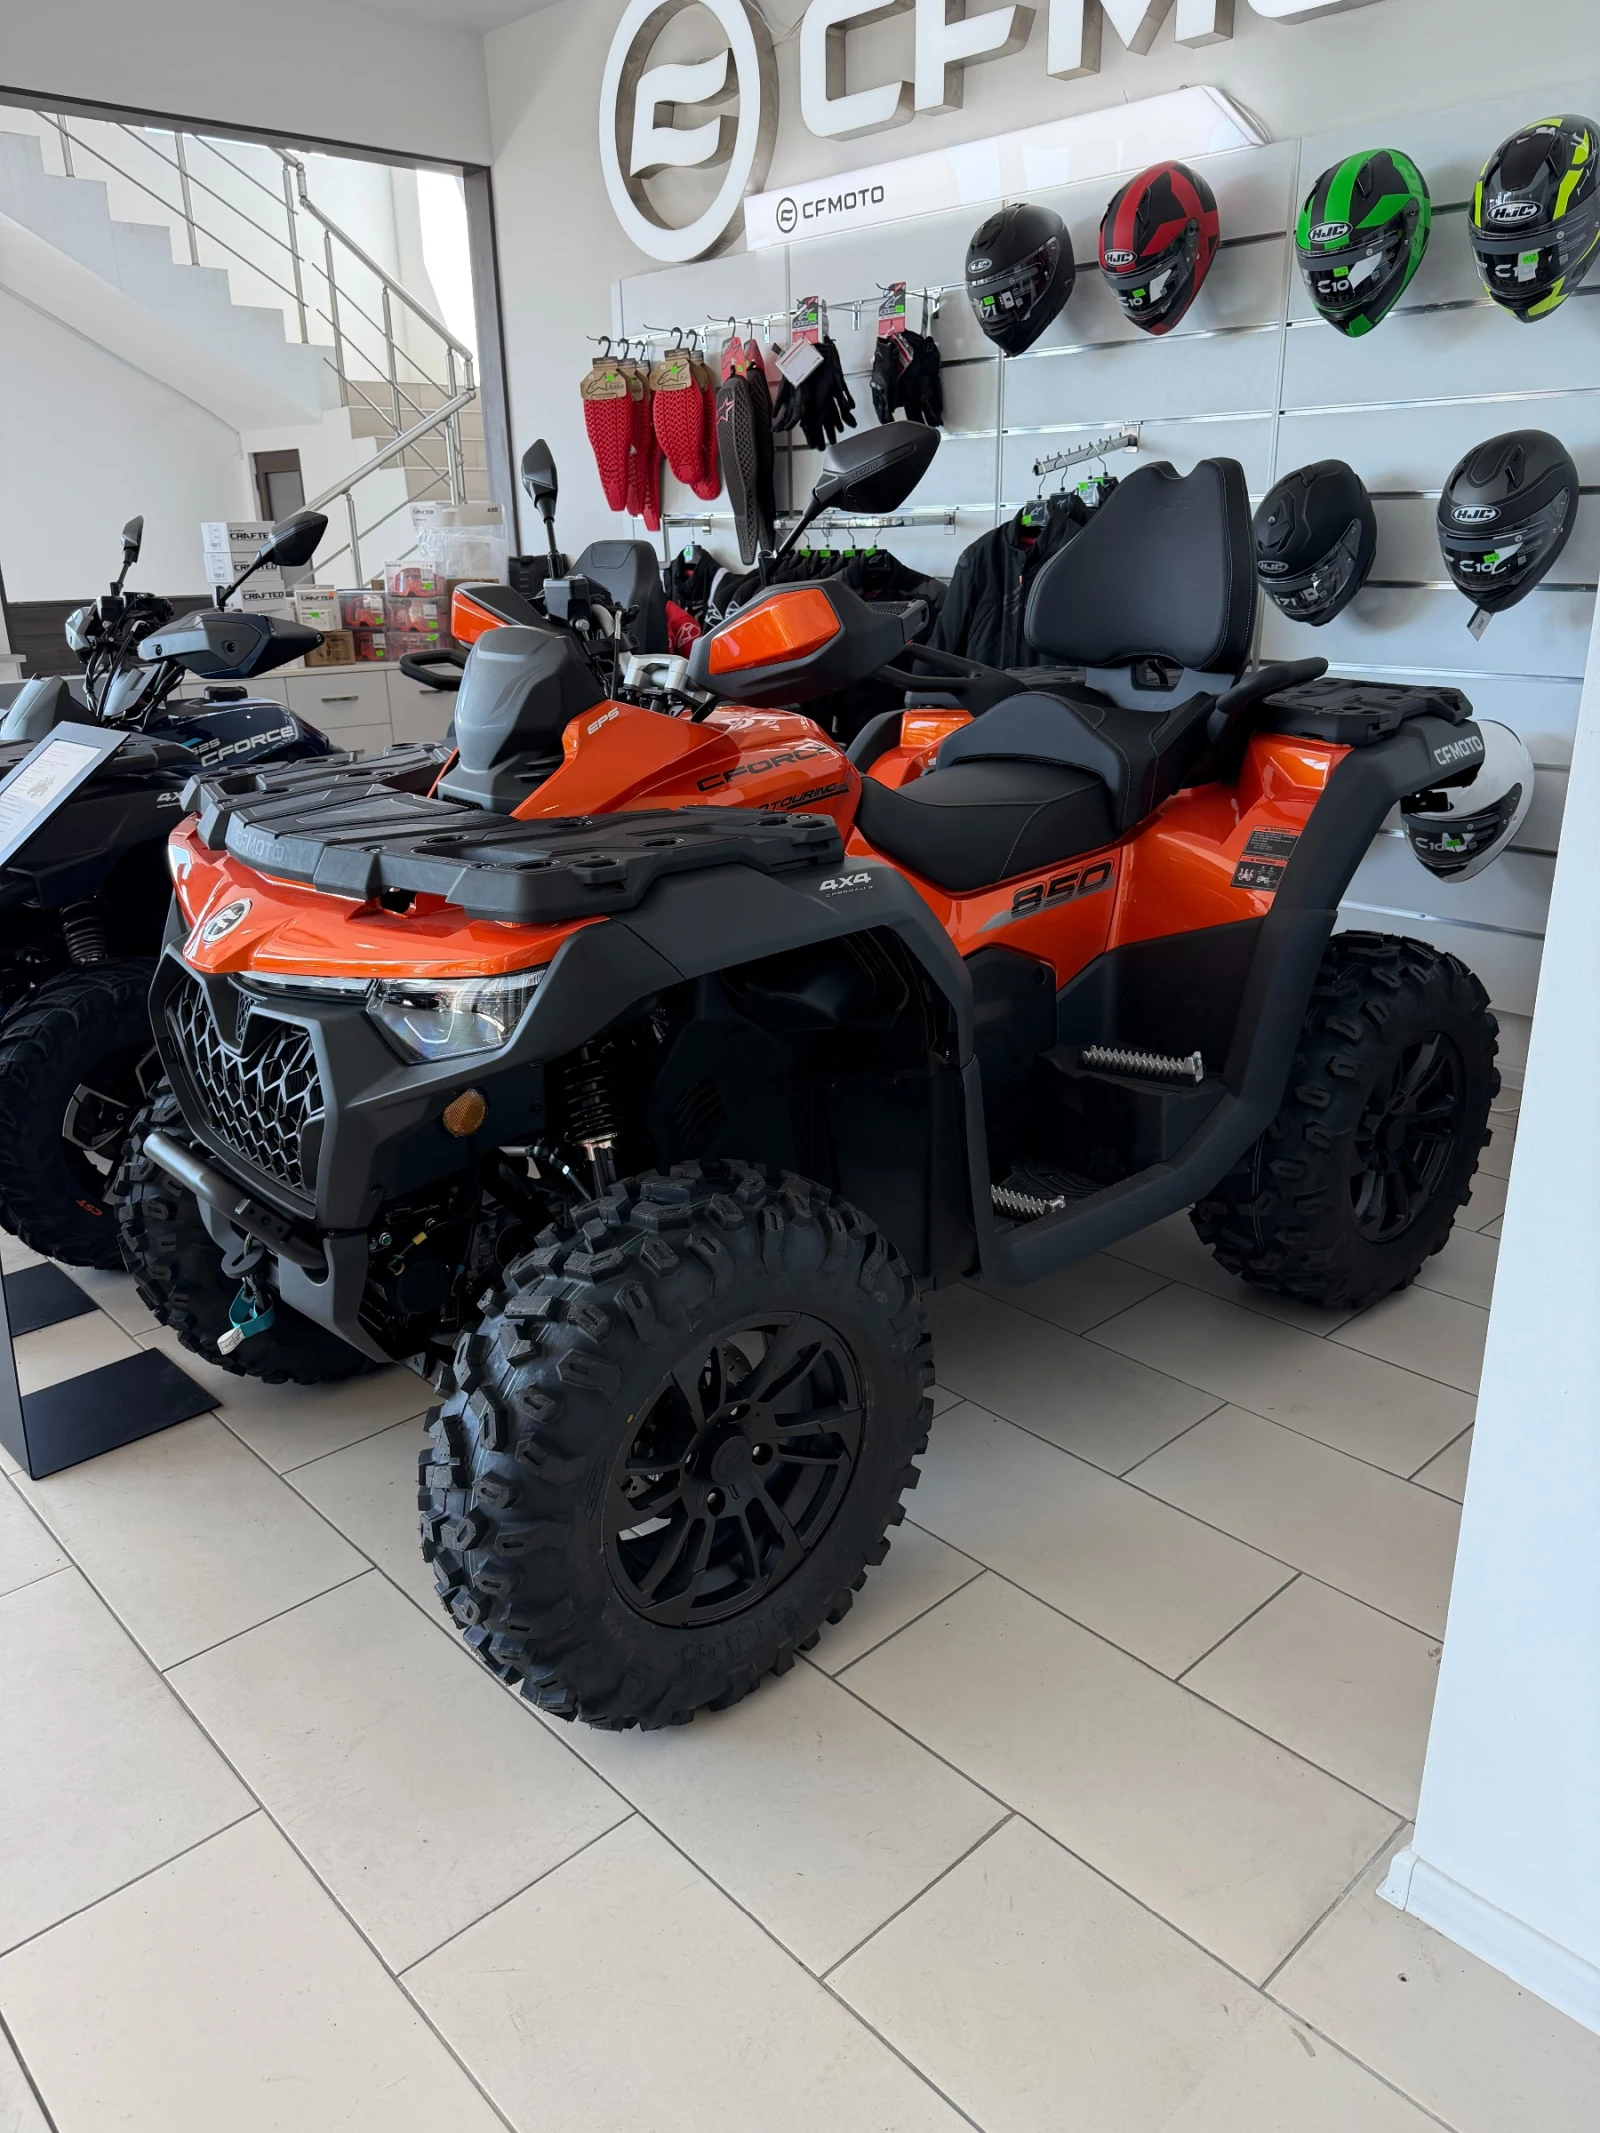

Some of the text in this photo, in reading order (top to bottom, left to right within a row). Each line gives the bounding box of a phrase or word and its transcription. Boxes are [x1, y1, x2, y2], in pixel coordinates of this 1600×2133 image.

[799, 0, 1348, 138] CF
[802, 185, 884, 219] CFMOTO
[1493, 204, 1537, 219] HJC
[1311, 224, 1347, 240] HJC
[1105, 252, 1132, 264] HJC
[1318, 280, 1349, 293] C10
[1456, 508, 1494, 520] HJC
[229, 531, 270, 540] CRAFTE
[234, 563, 277, 571] CRTED
[1460, 560, 1493, 573] C10
[243, 591, 284, 600] CRAFTED
[587, 707, 619, 735] EPS
[201, 725, 295, 767] CFORCE
[1433, 735, 1484, 765] CFMOTO
[156, 791, 183, 802] 4X
[819, 872, 872, 891] 4X4
[1011, 858, 1115, 918] 850
[76, 1199, 103, 1216] CST
